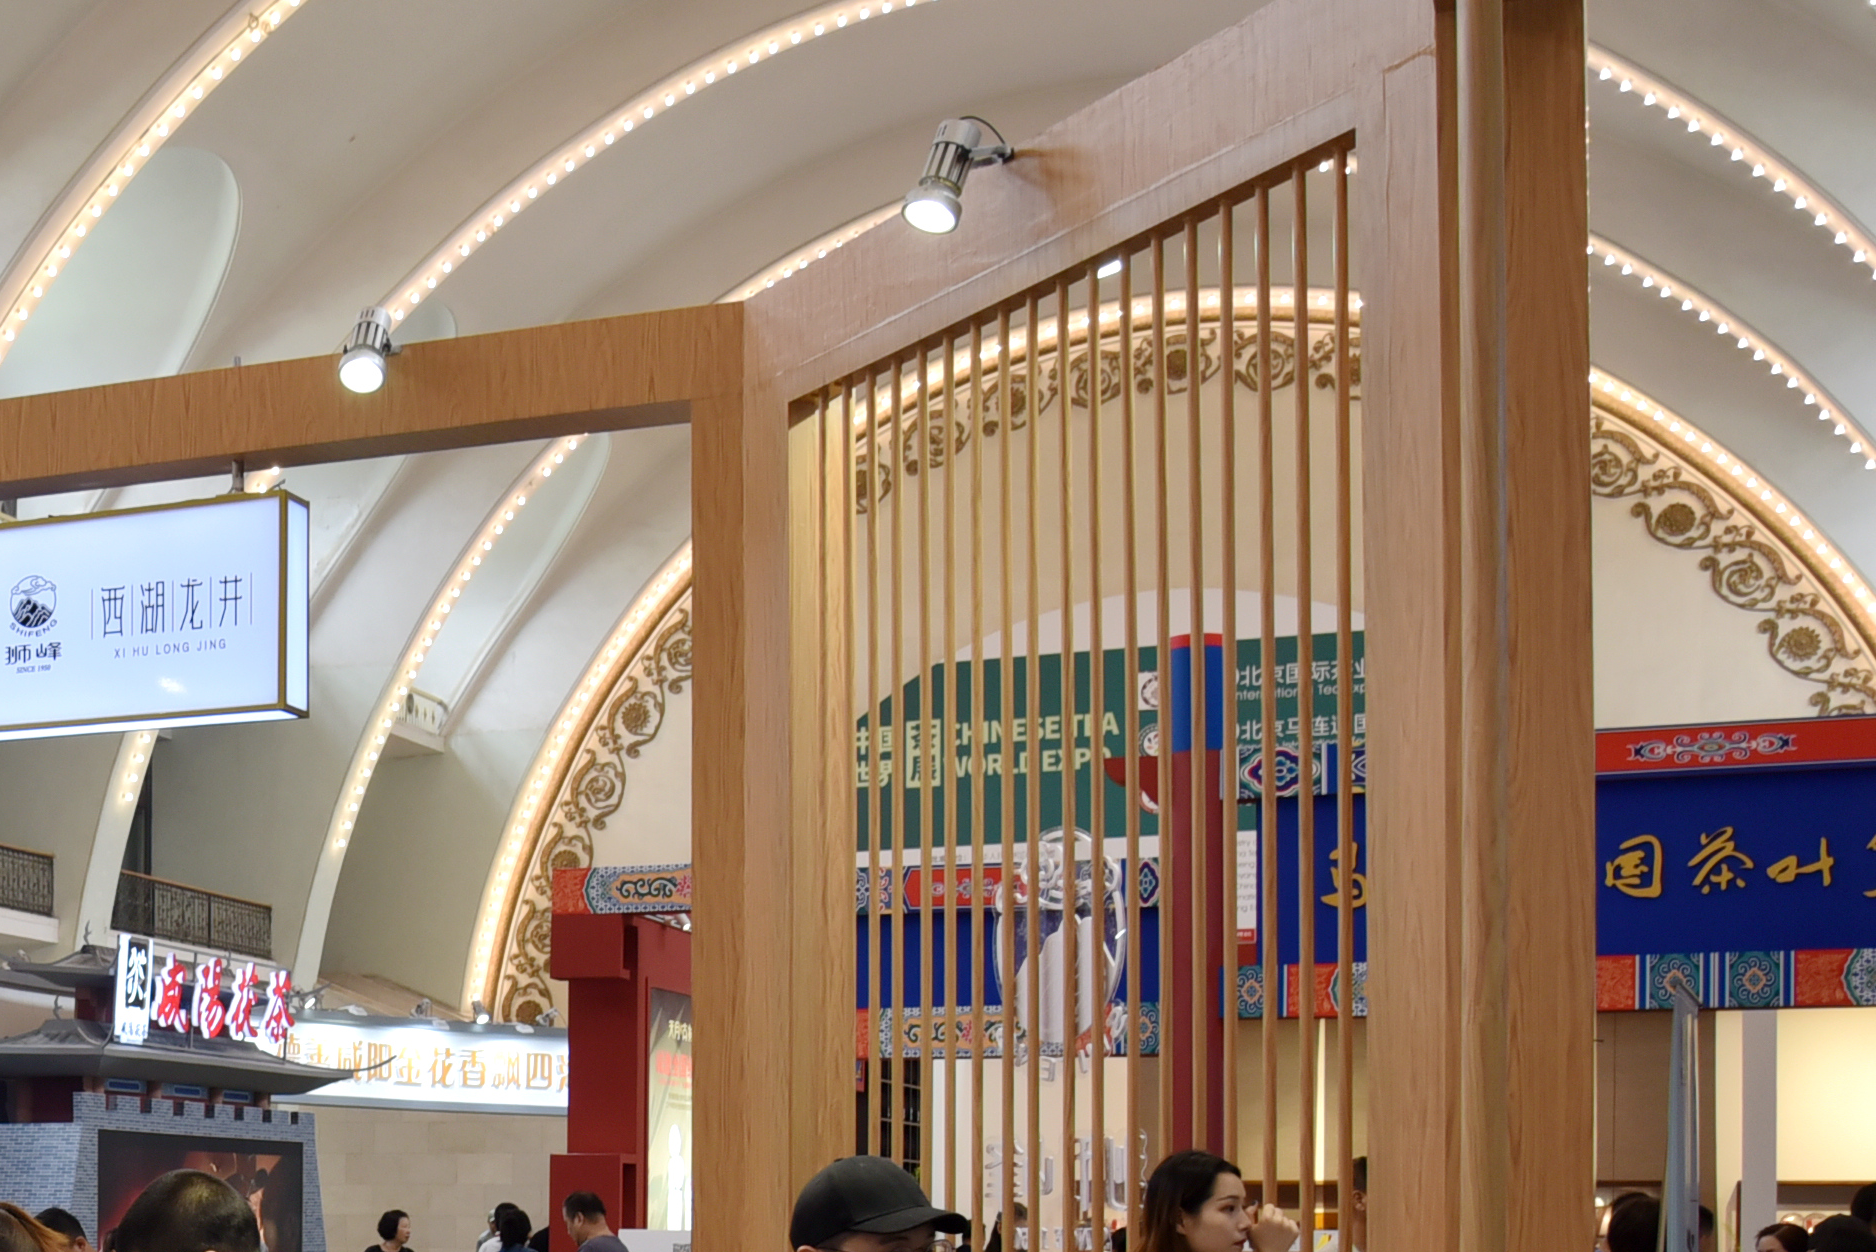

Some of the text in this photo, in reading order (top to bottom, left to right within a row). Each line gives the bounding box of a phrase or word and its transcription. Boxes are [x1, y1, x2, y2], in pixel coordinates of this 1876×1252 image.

[100, 575, 244, 638] 西湖龙井
[9, 619, 58, 638] SHIFENG
[4, 642, 62, 666] 狮峰
[114, 639, 227, 660] XI HU LONG JING
